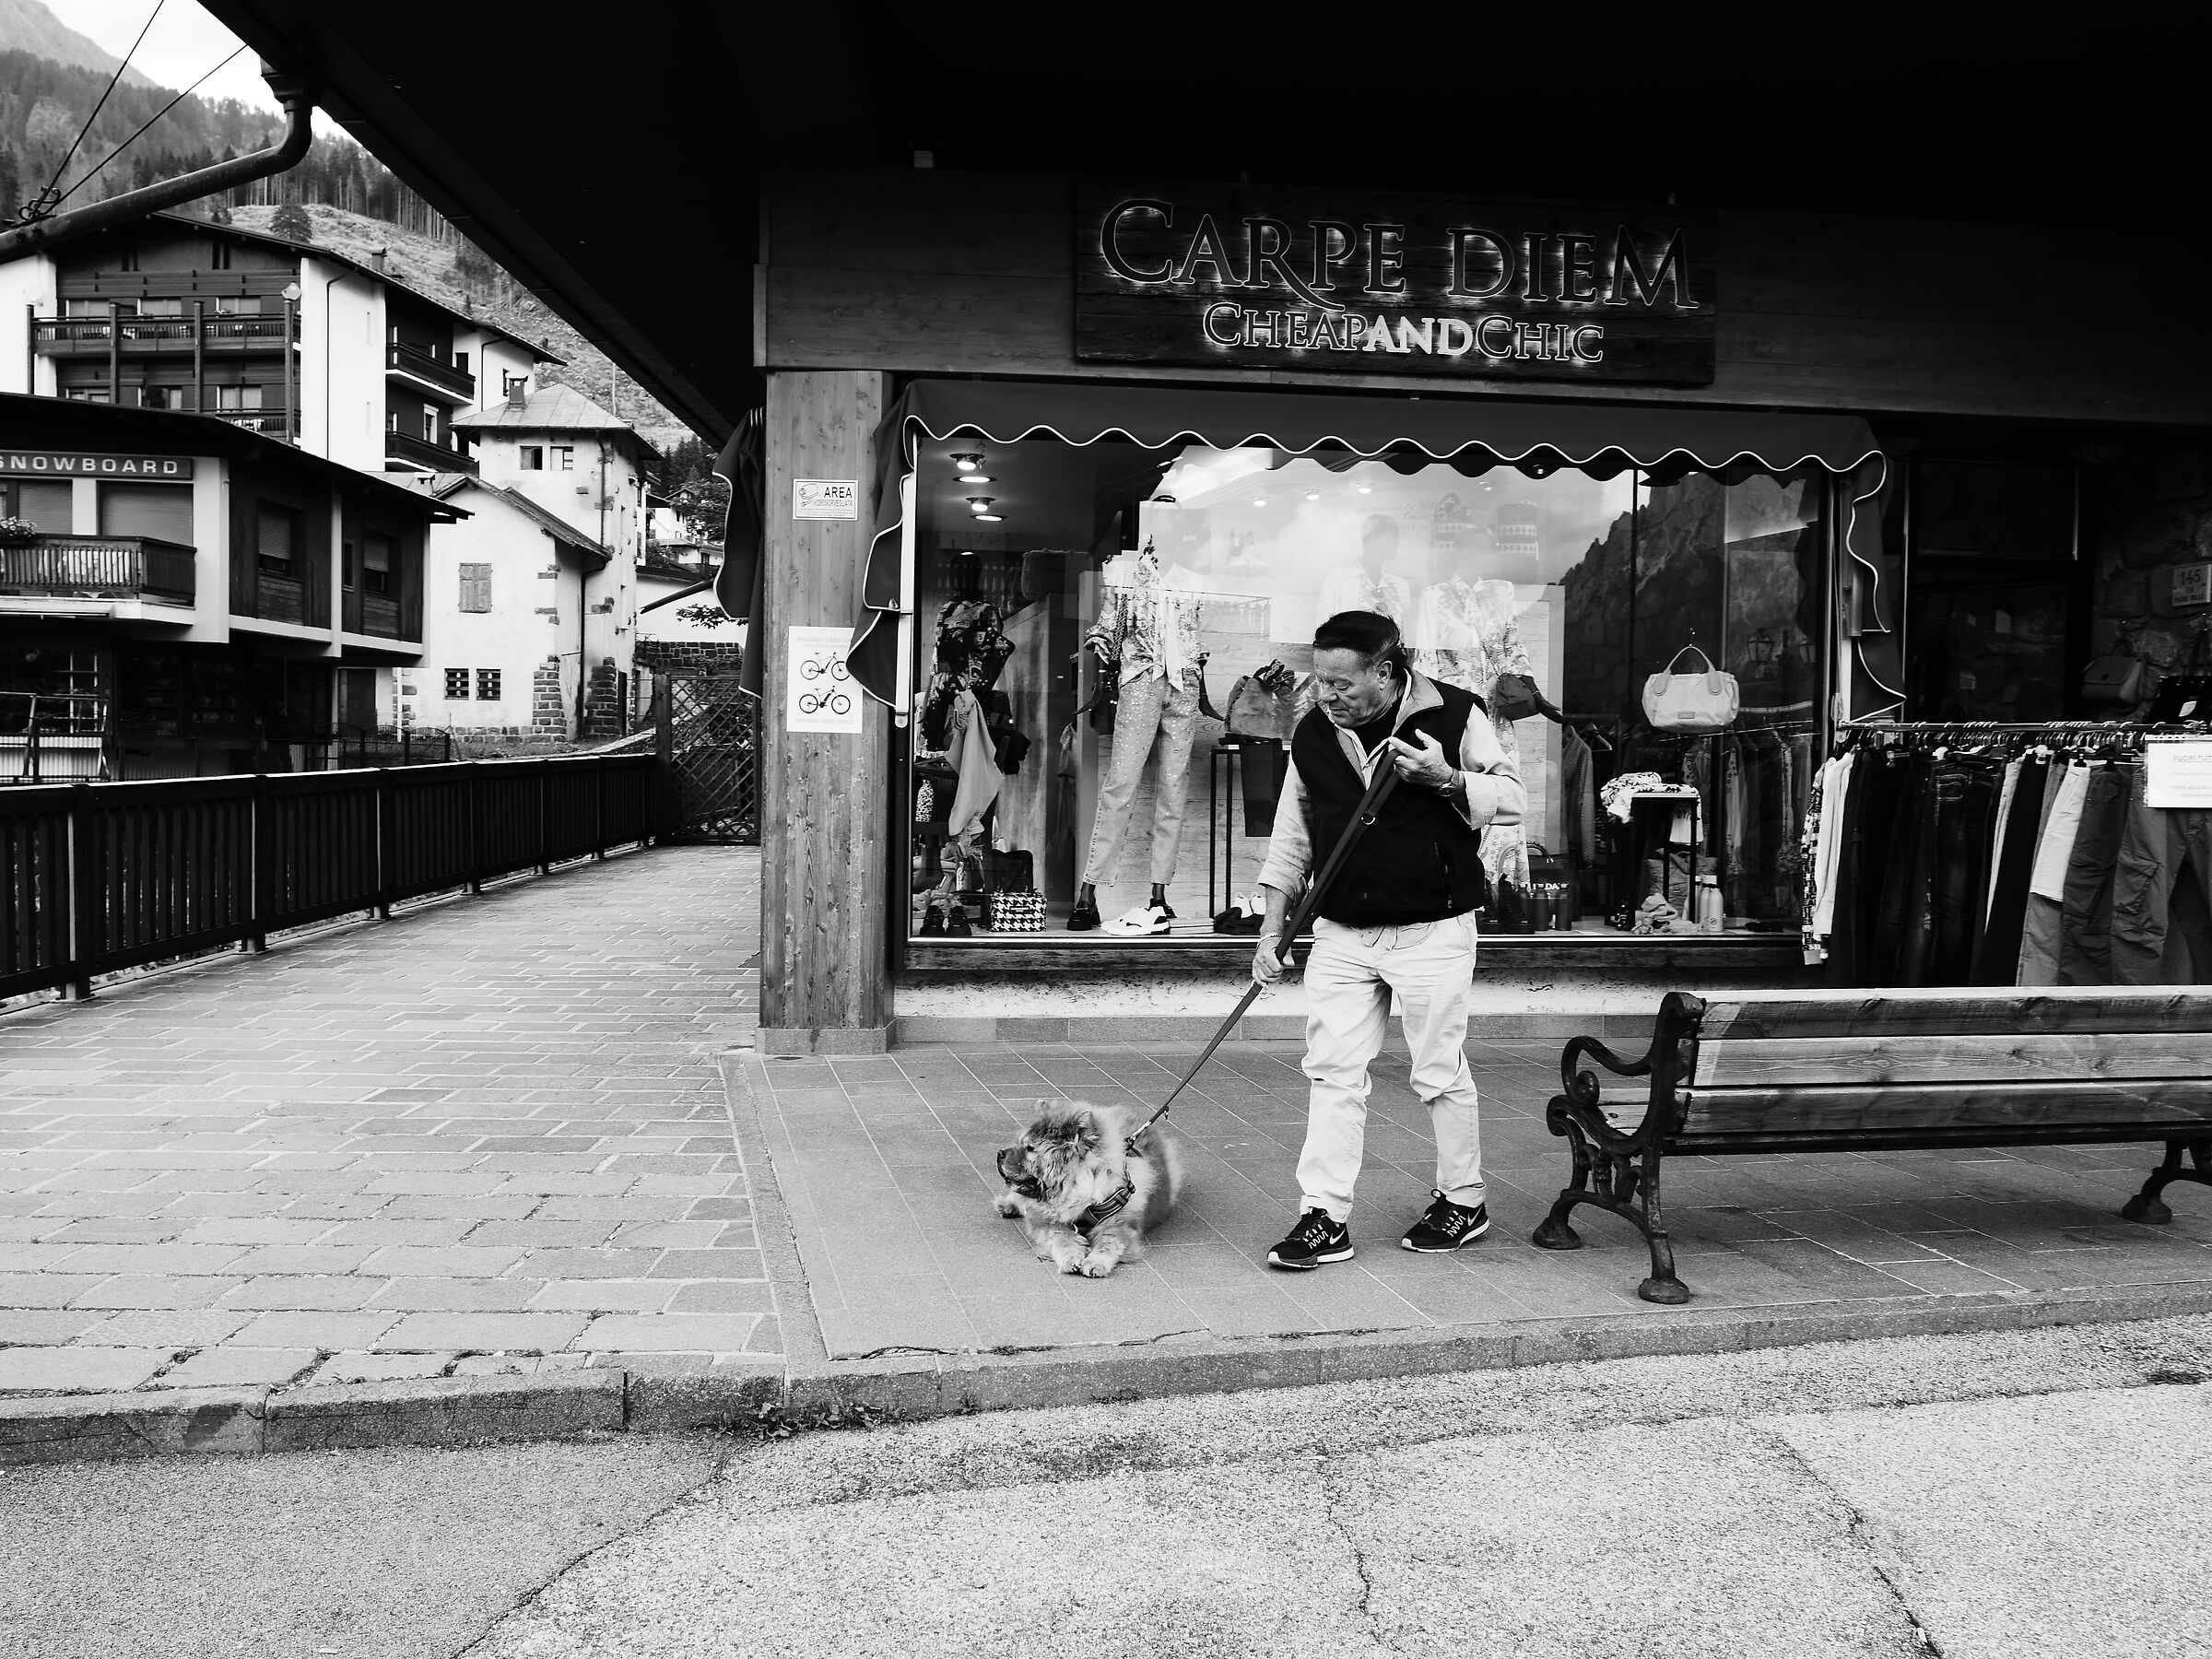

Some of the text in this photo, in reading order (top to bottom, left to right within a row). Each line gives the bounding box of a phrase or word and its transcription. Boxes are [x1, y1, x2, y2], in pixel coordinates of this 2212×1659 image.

[1100, 198, 1700, 312] CARPE DIEM
[0, 454, 178, 475] NOWBOARD
[823, 486, 853, 499] AREA
[2181, 569, 2202, 586] 145
